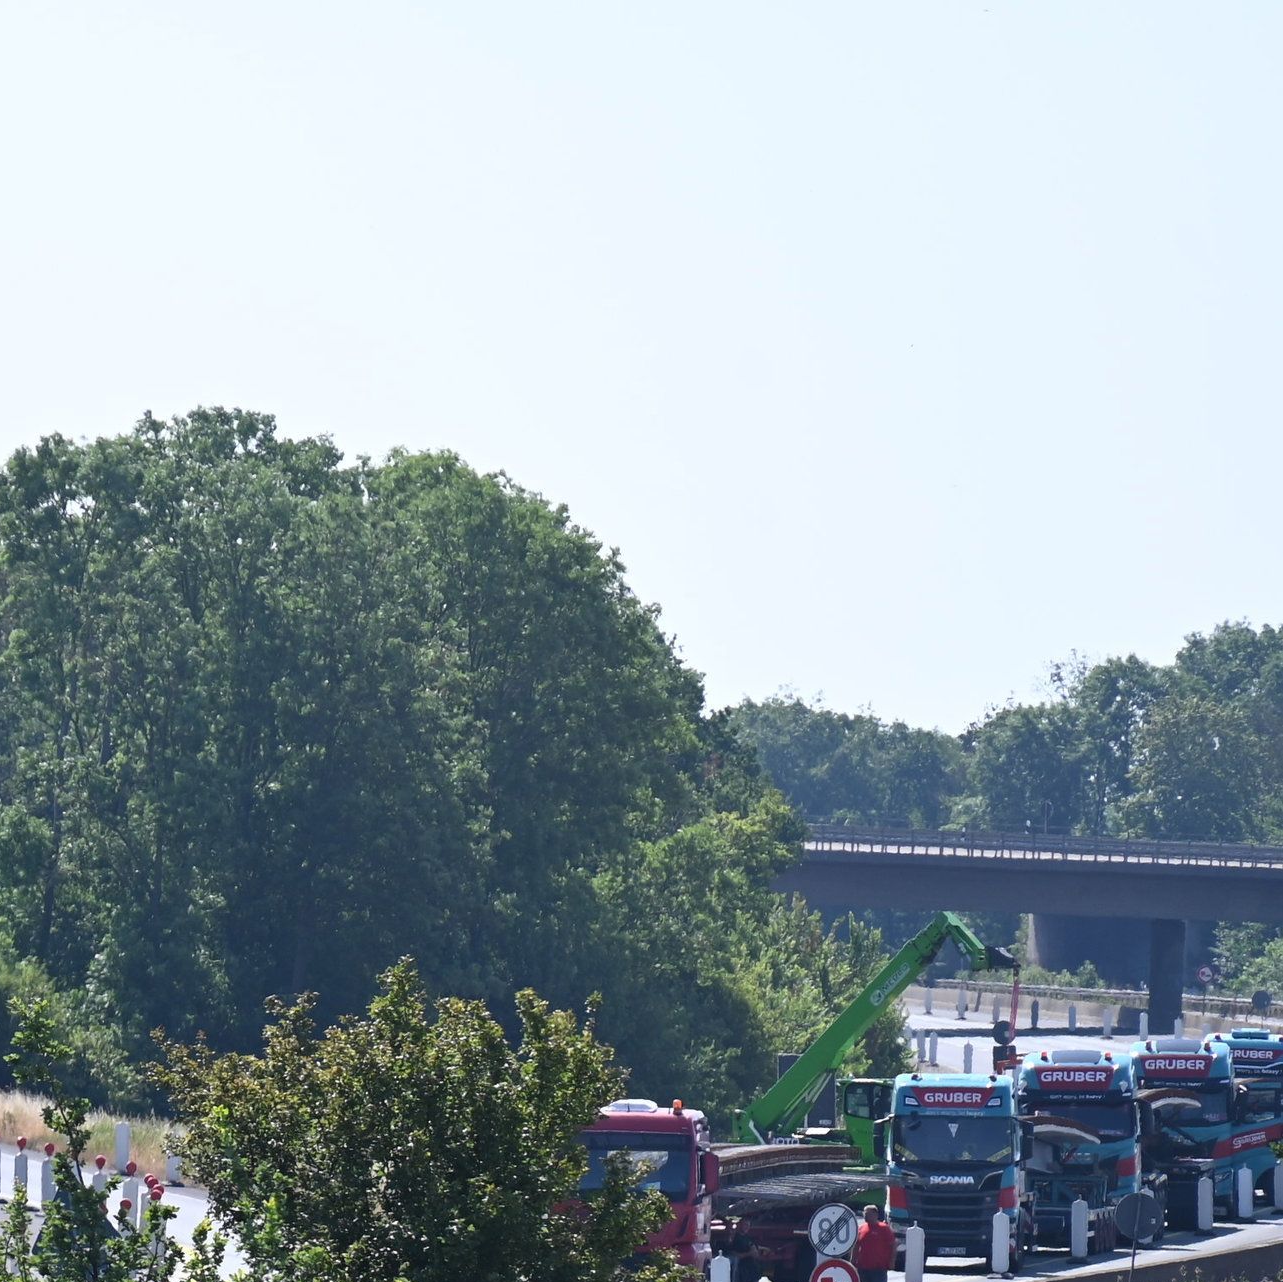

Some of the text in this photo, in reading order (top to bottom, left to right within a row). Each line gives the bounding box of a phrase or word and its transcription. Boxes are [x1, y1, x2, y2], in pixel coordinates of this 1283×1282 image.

[1145, 1059, 1206, 1070] GRUBER
[1041, 1071, 1107, 1082] GRUBER
[924, 1092, 982, 1103] GRUBER
[930, 1175, 974, 1184] SCANIA
[818, 1217, 850, 1244] 80
